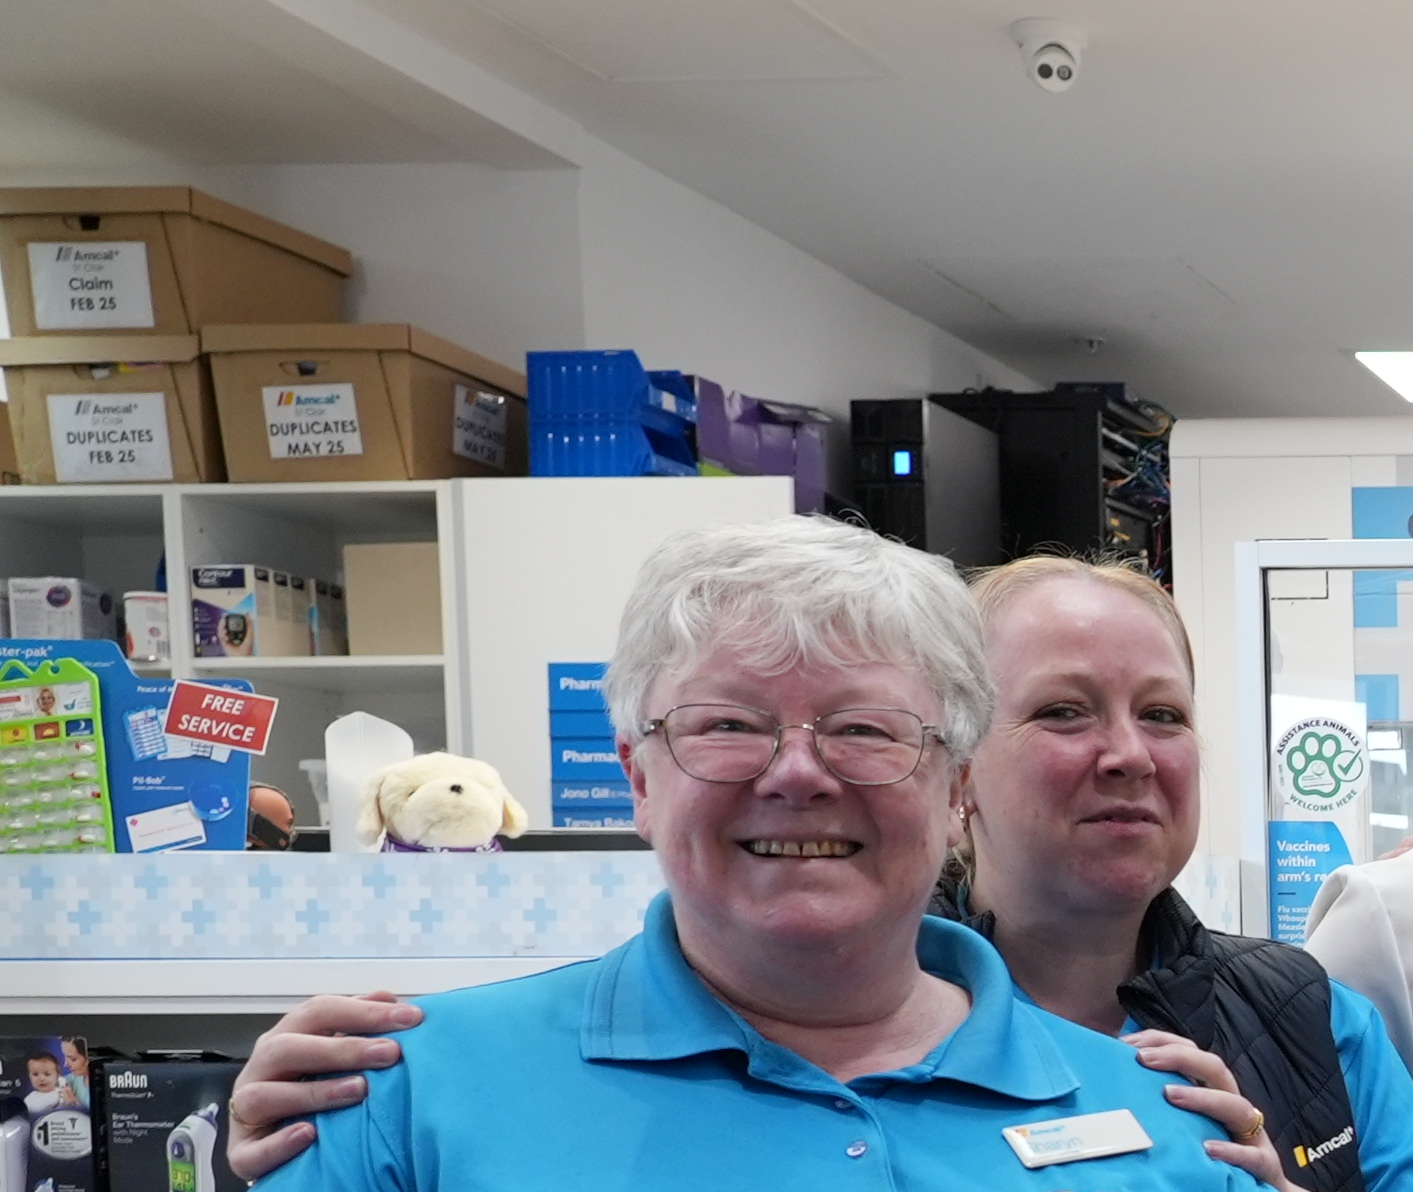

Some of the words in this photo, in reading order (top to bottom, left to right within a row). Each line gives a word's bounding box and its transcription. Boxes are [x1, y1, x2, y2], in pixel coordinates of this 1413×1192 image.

[69, 277, 114, 291] Claim
[70, 298, 94, 311] FEB
[99, 297, 117, 310] 25
[269, 419, 357, 436] DUPLICATES
[66, 429, 153, 445] DUPLICATES
[287, 441, 323, 456] MAY
[327, 440, 345, 454] 25
[89, 451, 114, 465] FEB
[118, 450, 136, 463] 25
[0, 645, 49, 659] ter-pak
[560, 677, 603, 691] Pharm
[201, 693, 245, 716] FREE
[178, 715, 256, 743] SERVICE
[1276, 719, 1321, 755] ASSISTANCE
[1322, 720, 1360, 747] ANIMALS
[1289, 792, 1335, 812] WELCOME
[1335, 787, 1358, 808] HERE
[1276, 840, 1331, 853] Vaccines
[1276, 855, 1317, 867] within
[109, 1071, 148, 1089] BRAUN
